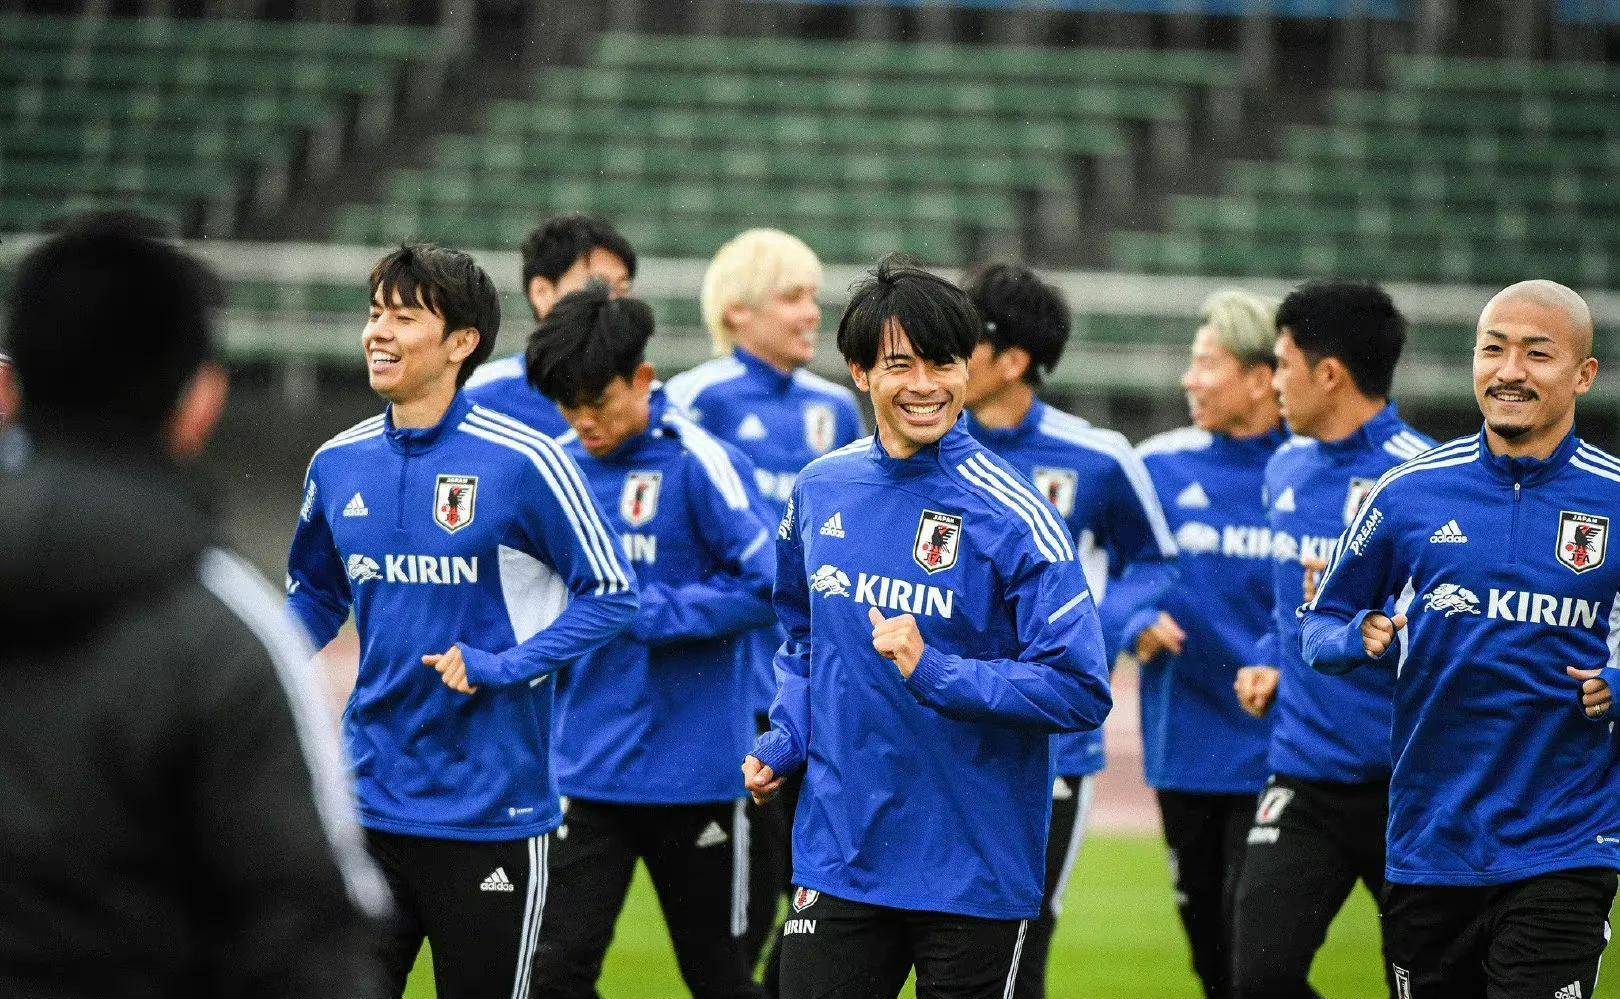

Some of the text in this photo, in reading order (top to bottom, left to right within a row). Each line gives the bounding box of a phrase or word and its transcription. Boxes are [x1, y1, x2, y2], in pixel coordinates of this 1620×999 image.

[932, 514, 955, 524] JAPAN
[1572, 514, 1598, 524] JAPAN
[1350, 507, 1383, 556] DREAM
[1430, 534, 1468, 544] adidas
[923, 552, 942, 565] JFA
[1568, 552, 1590, 564] JFA
[385, 554, 478, 584] KIRIN
[854, 572, 954, 619] KIRIN
[1487, 588, 1601, 629] KIRIN
[480, 881, 514, 892] adidas
[784, 919, 817, 936] IRIN
